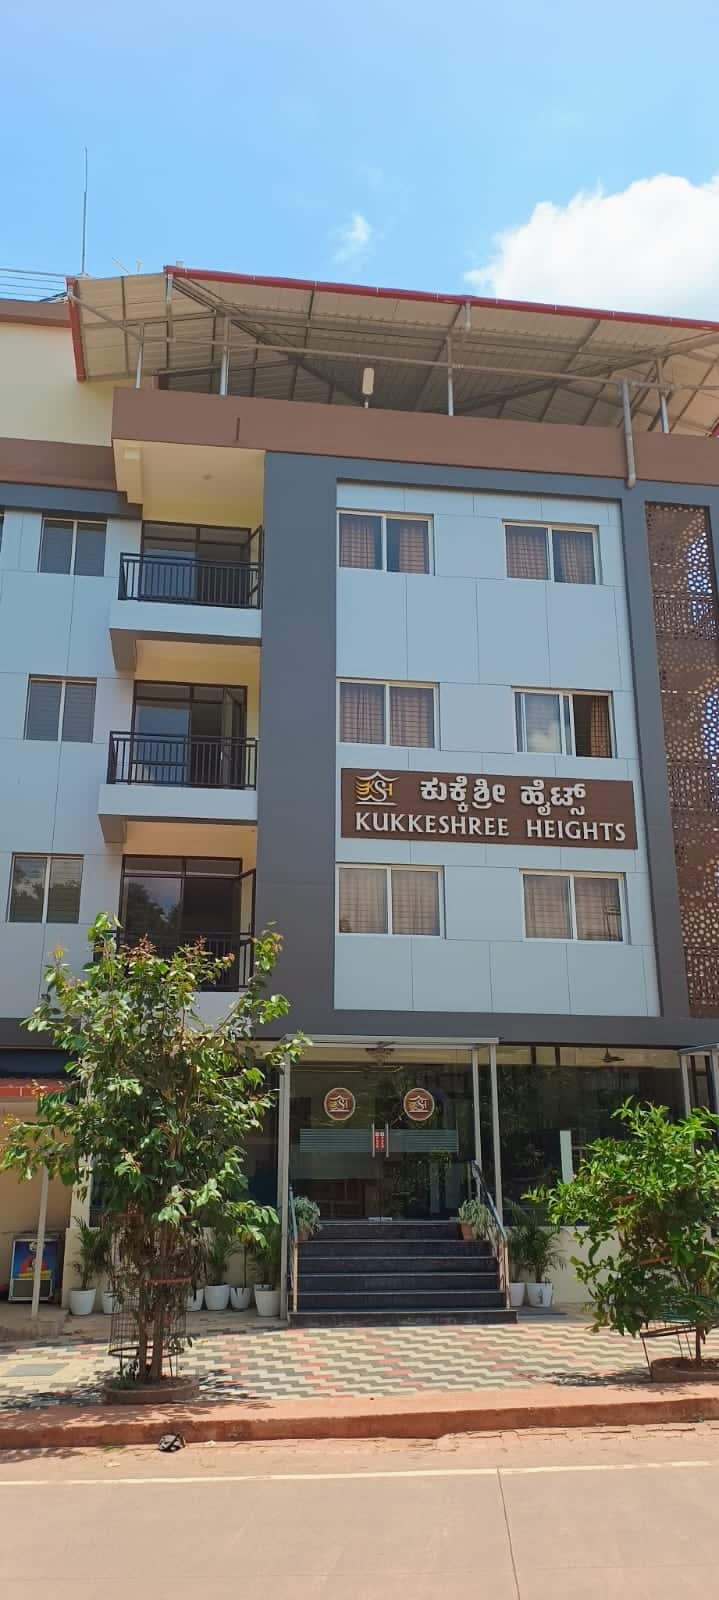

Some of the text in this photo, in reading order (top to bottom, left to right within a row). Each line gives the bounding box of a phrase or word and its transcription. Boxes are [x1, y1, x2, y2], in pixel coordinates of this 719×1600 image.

[420, 775, 586, 816] ಕುಕ್ಕೆಶ್ರೀ ಹೈಟ್ಸ್
[355, 812, 626, 842] KUKKESHREE HEIGHTS
